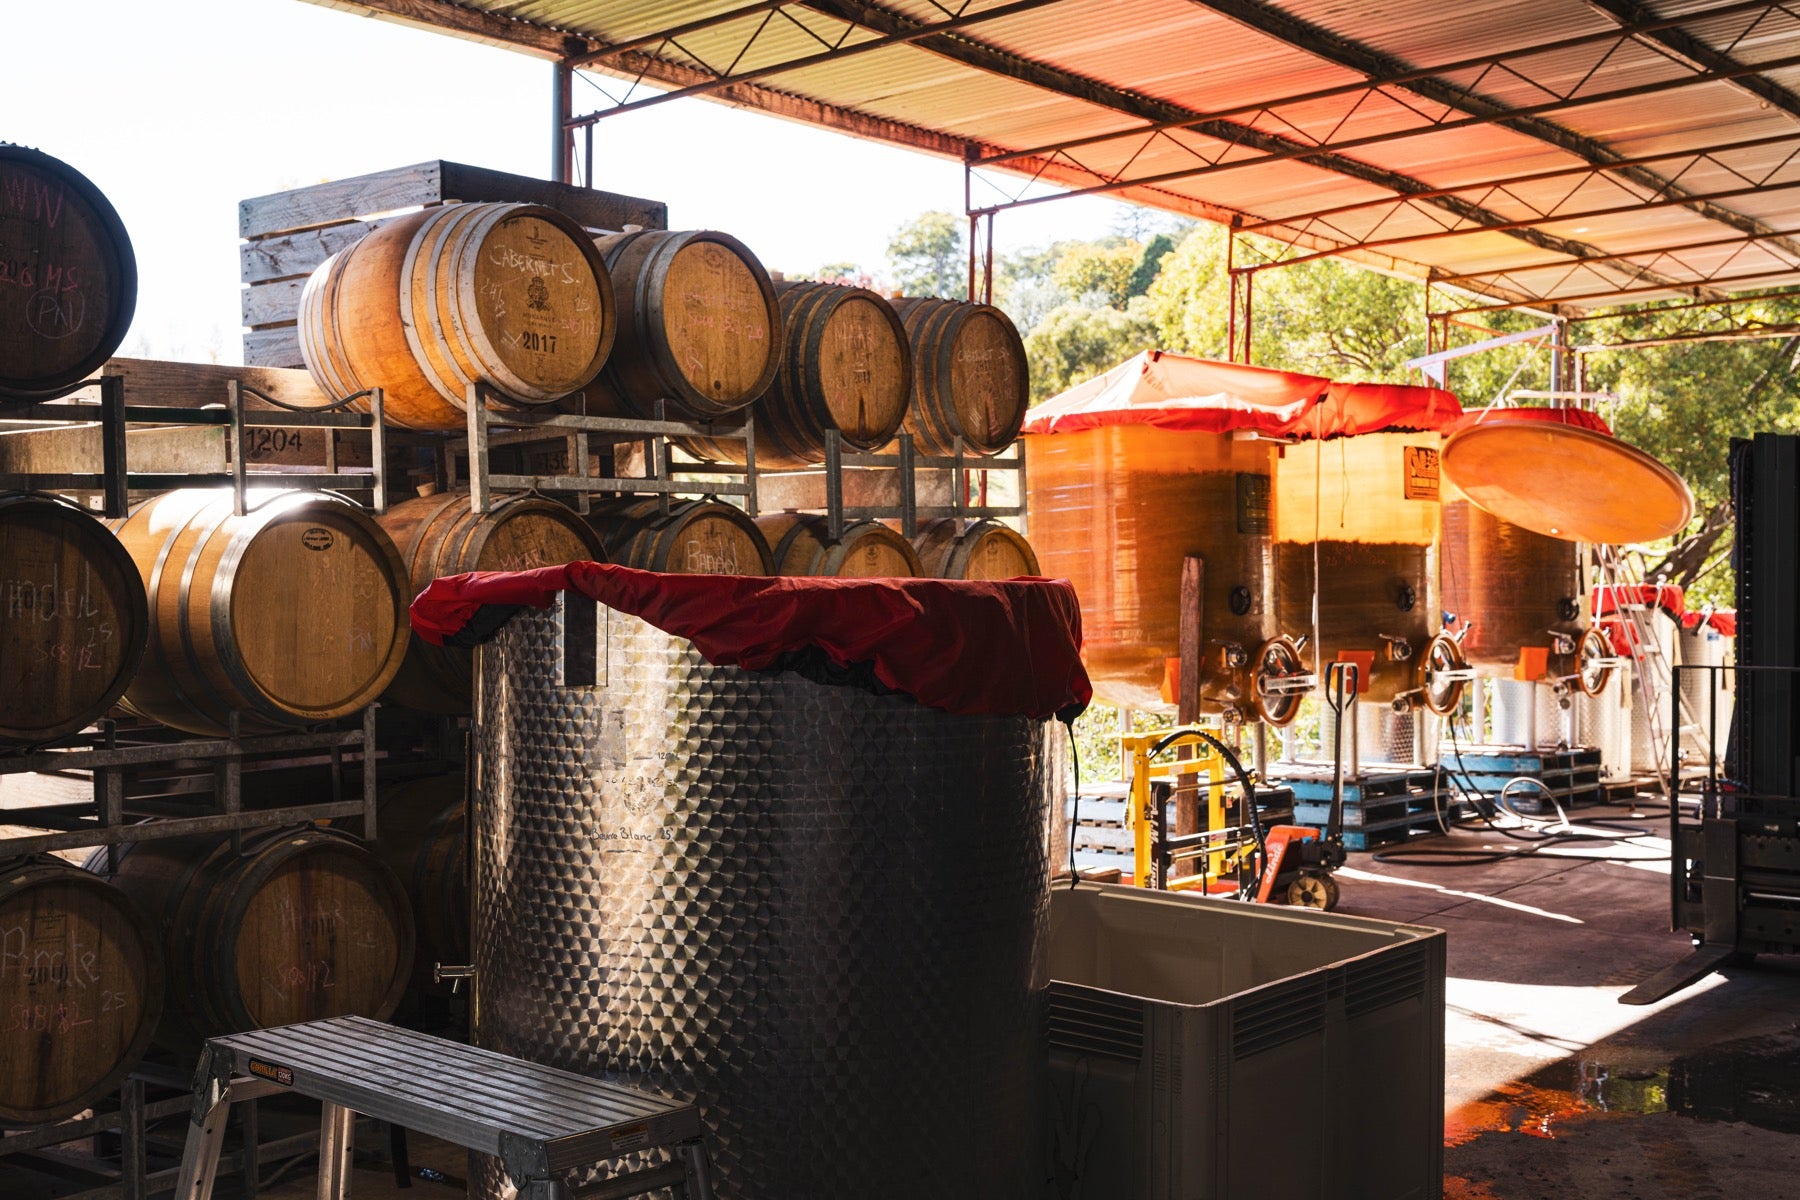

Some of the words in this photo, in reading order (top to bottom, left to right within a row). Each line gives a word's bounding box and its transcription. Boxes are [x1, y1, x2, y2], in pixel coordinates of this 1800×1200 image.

[523, 331, 557, 355] 2017
[247, 429, 303, 452] 1204
[620, 827, 652, 841] Blanc
